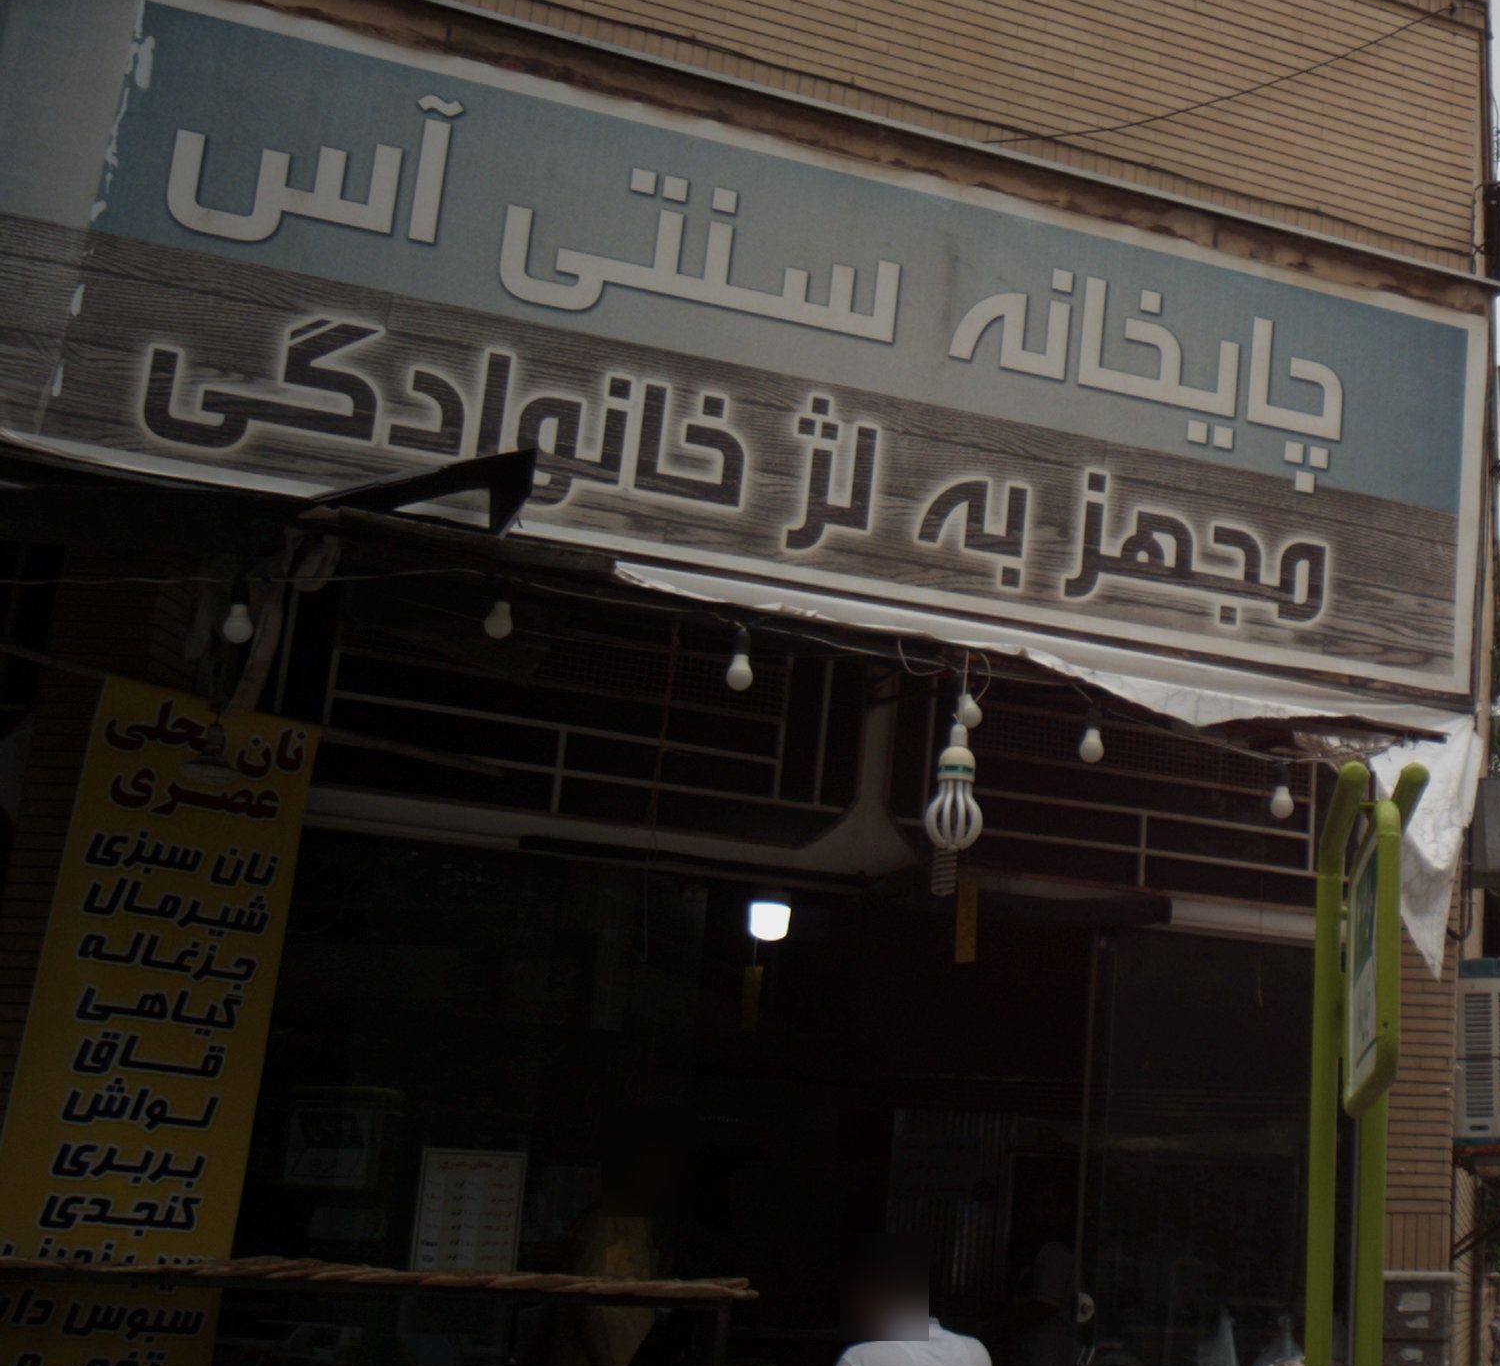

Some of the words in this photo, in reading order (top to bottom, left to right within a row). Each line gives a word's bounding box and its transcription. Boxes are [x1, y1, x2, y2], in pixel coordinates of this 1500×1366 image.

[166, 94, 466, 244] آس
[498, 166, 902, 345] سنتی
[947, 268, 1347, 495] چایخانه
[142, 319, 746, 509] خانوادگی
[781, 393, 881, 554] لژ
[915, 478, 1033, 594] به
[1061, 467, 1332, 627] مجهز
[104, 699, 224, 753] حلی
[235, 729, 306, 778] نان
[110, 767, 281, 819] عصری
[84, 831, 203, 875] سبزی
[210, 847, 280, 887] نان
[82, 877, 271, 937] شیرمال
[77, 932, 258, 990] جزغاله
[75, 986, 243, 1036] گیاهی
[72, 1031, 226, 1079] قاق
[61, 1077, 220, 1130] لواش
[52, 1142, 206, 1189] بربری
[39, 1194, 202, 1237] کنجدی
[62, 1302, 204, 1343] سبوس
